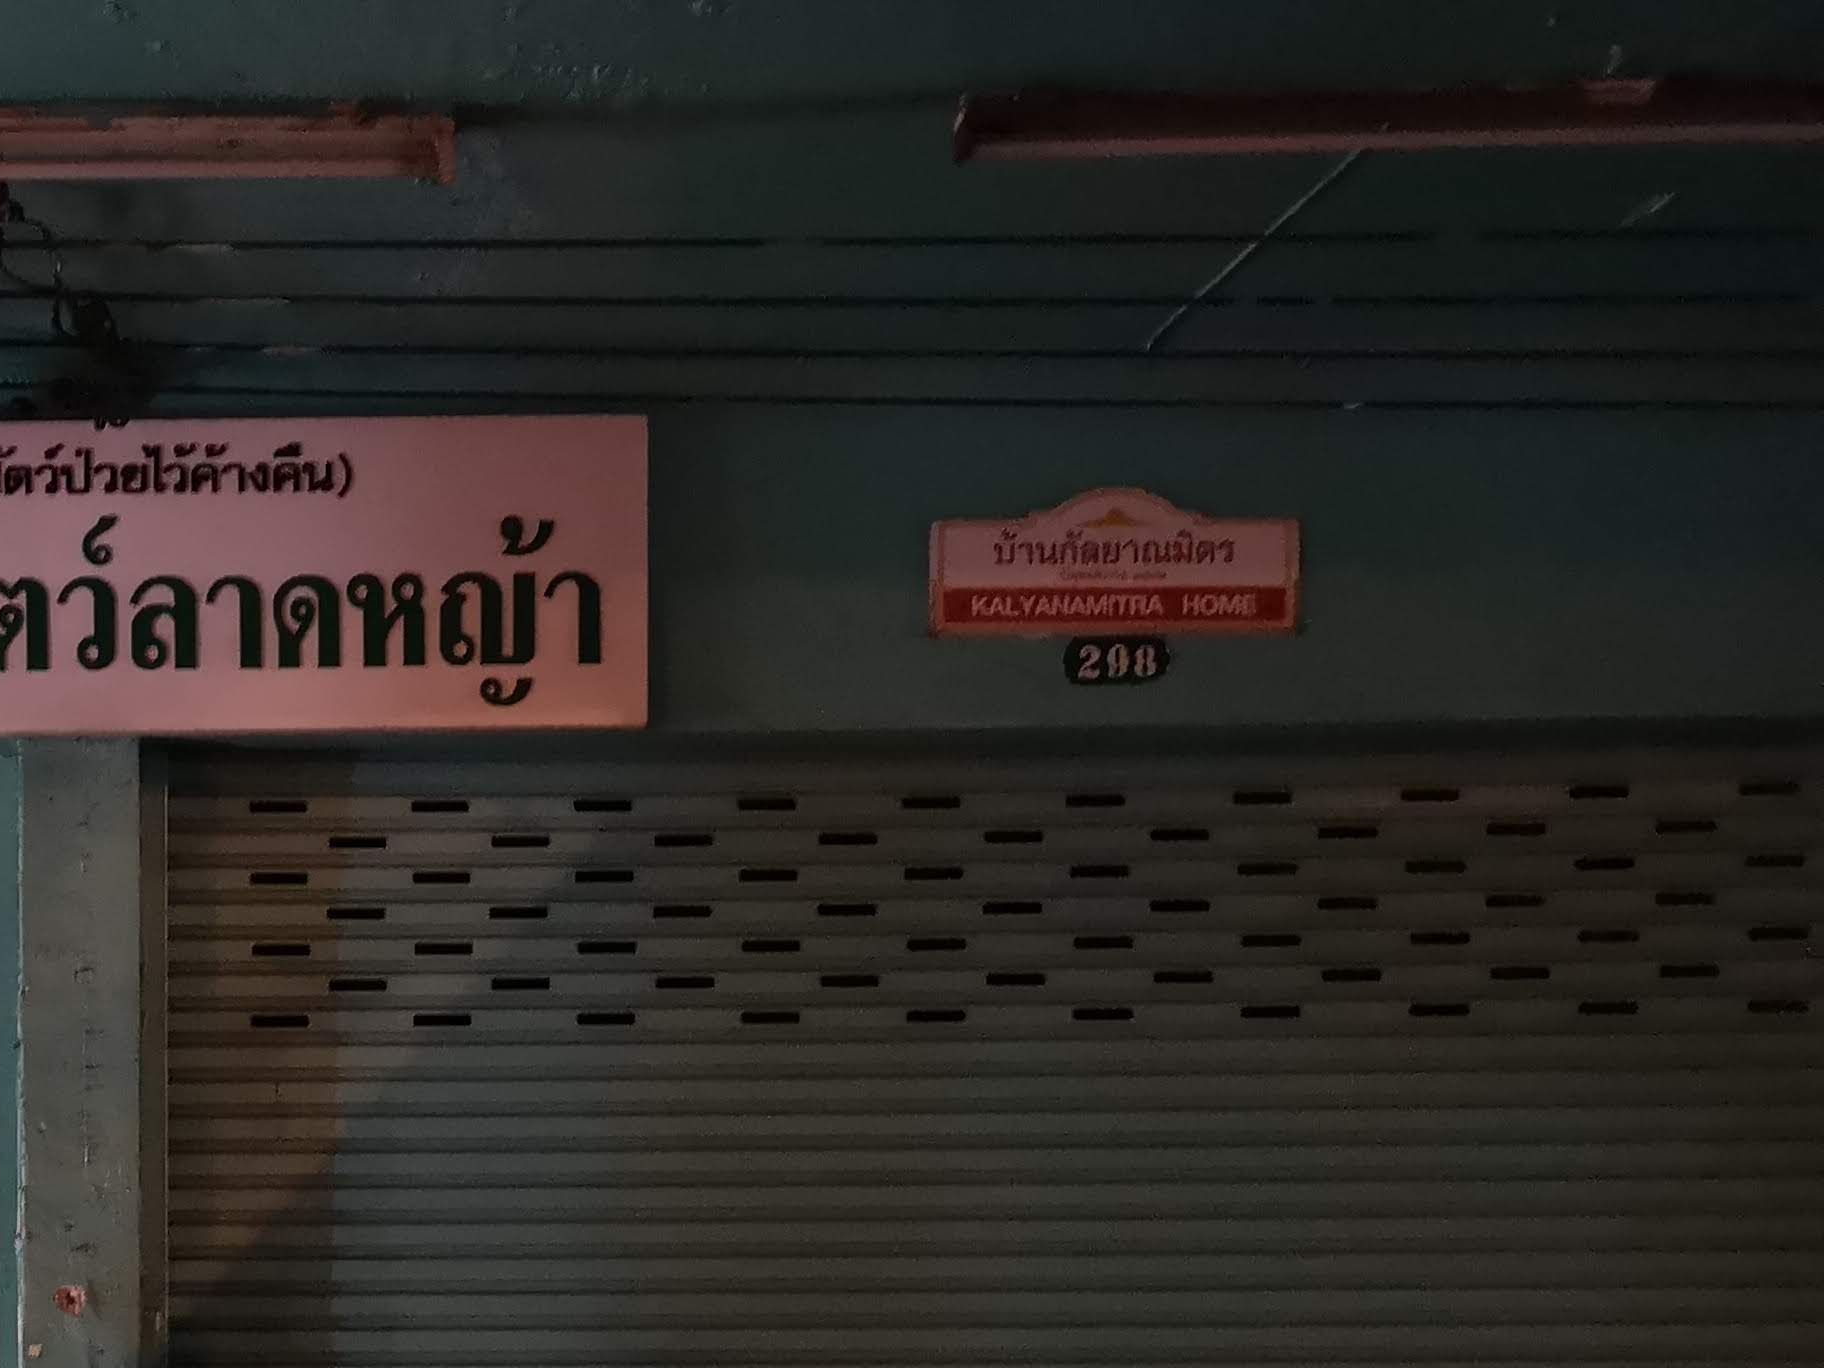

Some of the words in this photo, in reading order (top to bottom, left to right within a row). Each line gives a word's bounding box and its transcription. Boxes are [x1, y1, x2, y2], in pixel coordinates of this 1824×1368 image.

[993, 527, 1236, 566] บ้านกัลยาณมิตร
[971, 594, 1164, 617] KALYANAMITRA
[1182, 594, 1256, 617] HOME
[1077, 643, 1157, 680] 298
